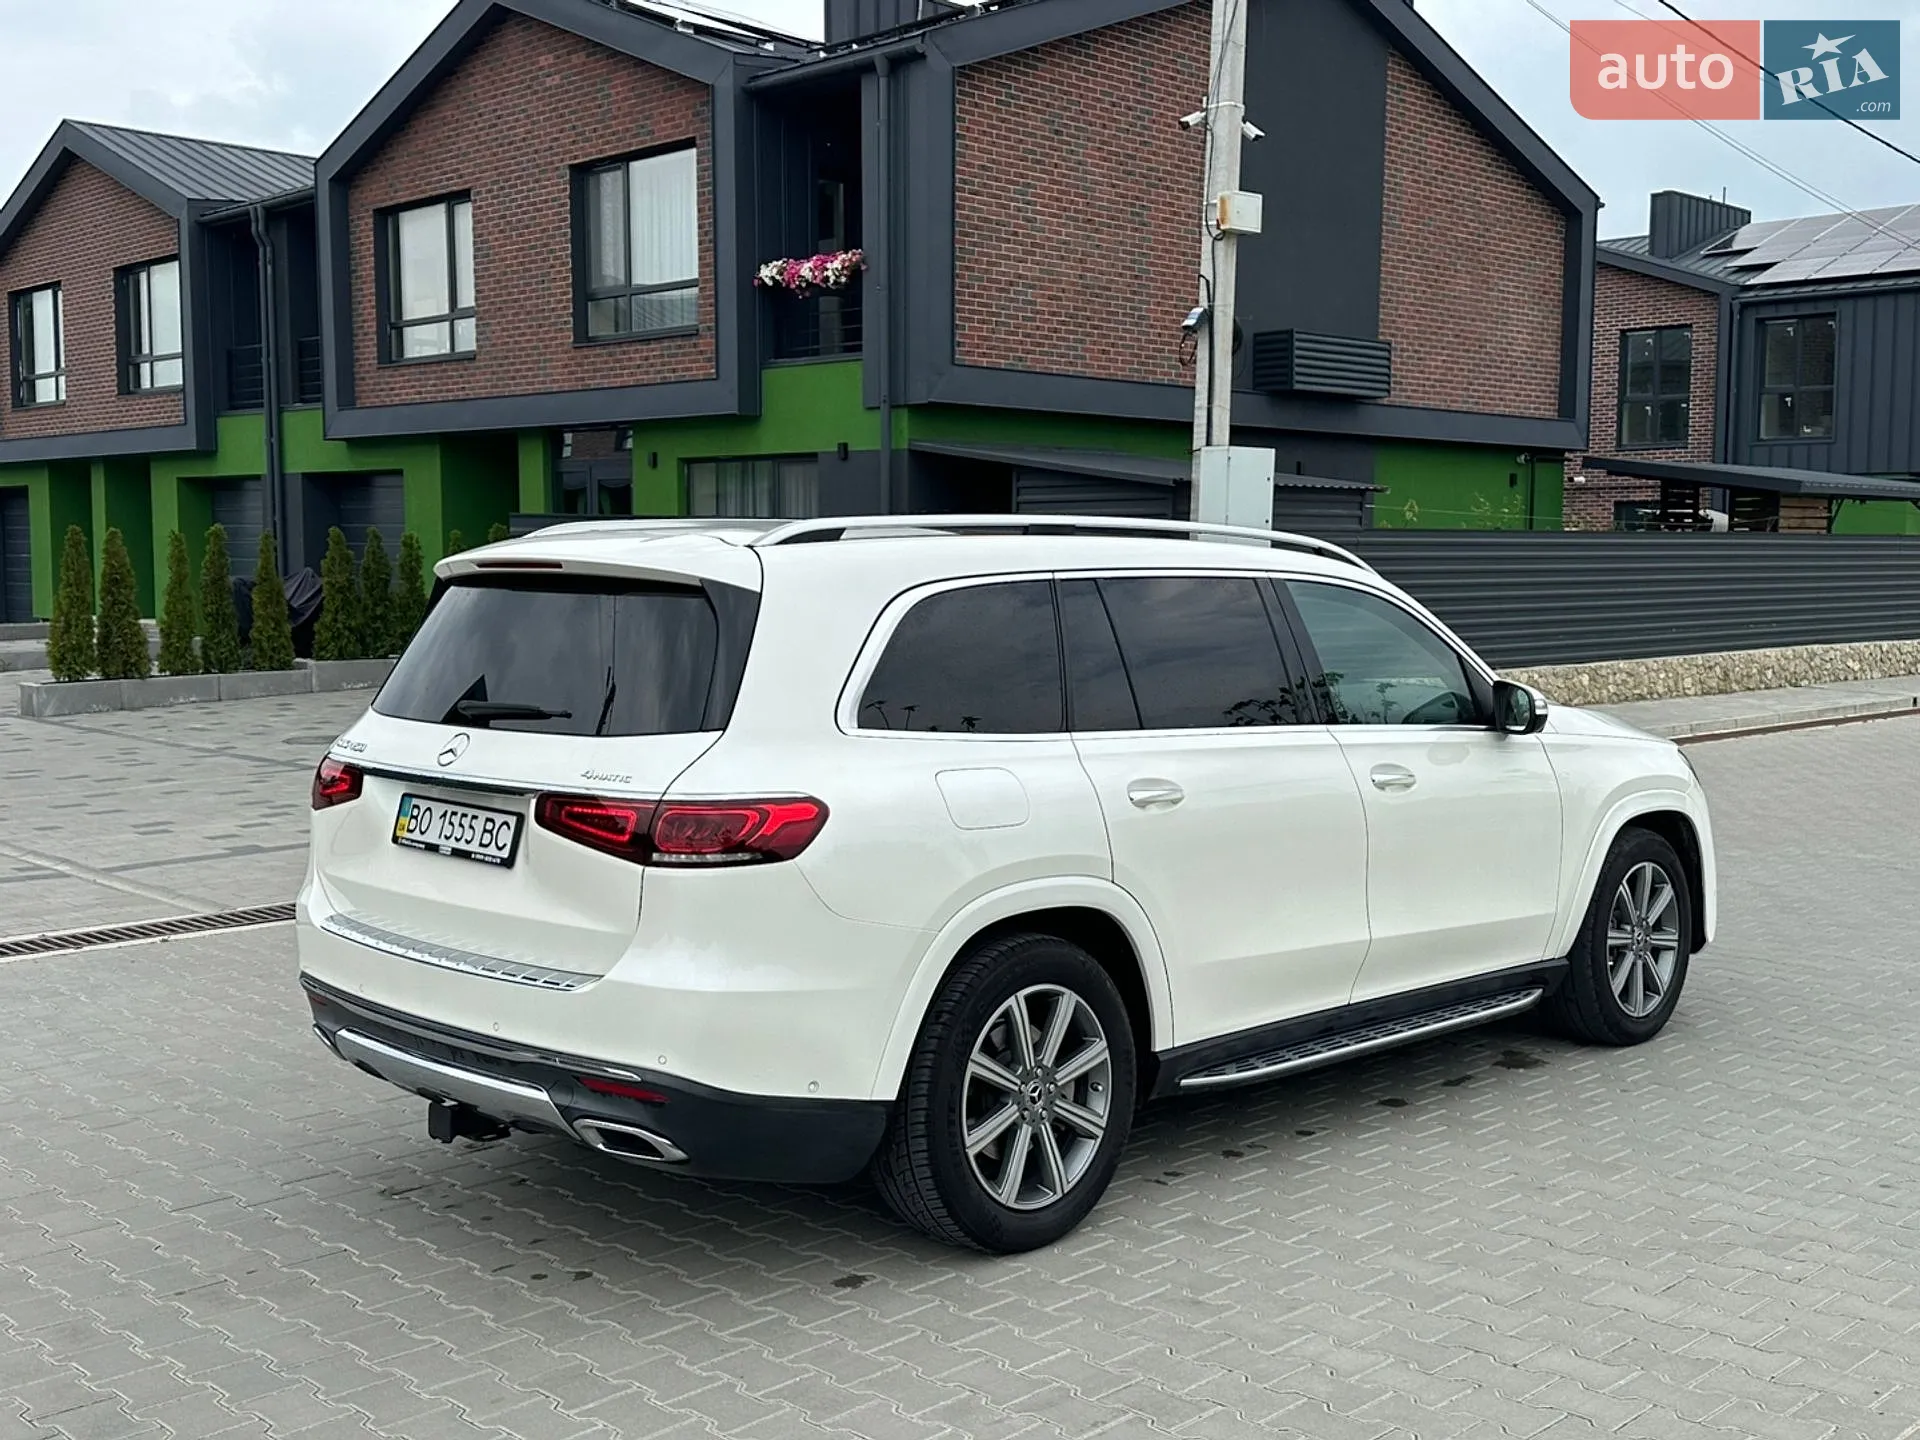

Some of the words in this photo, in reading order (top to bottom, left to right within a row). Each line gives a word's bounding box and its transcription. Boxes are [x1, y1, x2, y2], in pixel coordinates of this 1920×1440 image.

[407, 804, 433, 835] BO
[438, 809, 479, 845] 1555
[479, 816, 511, 851] BC
